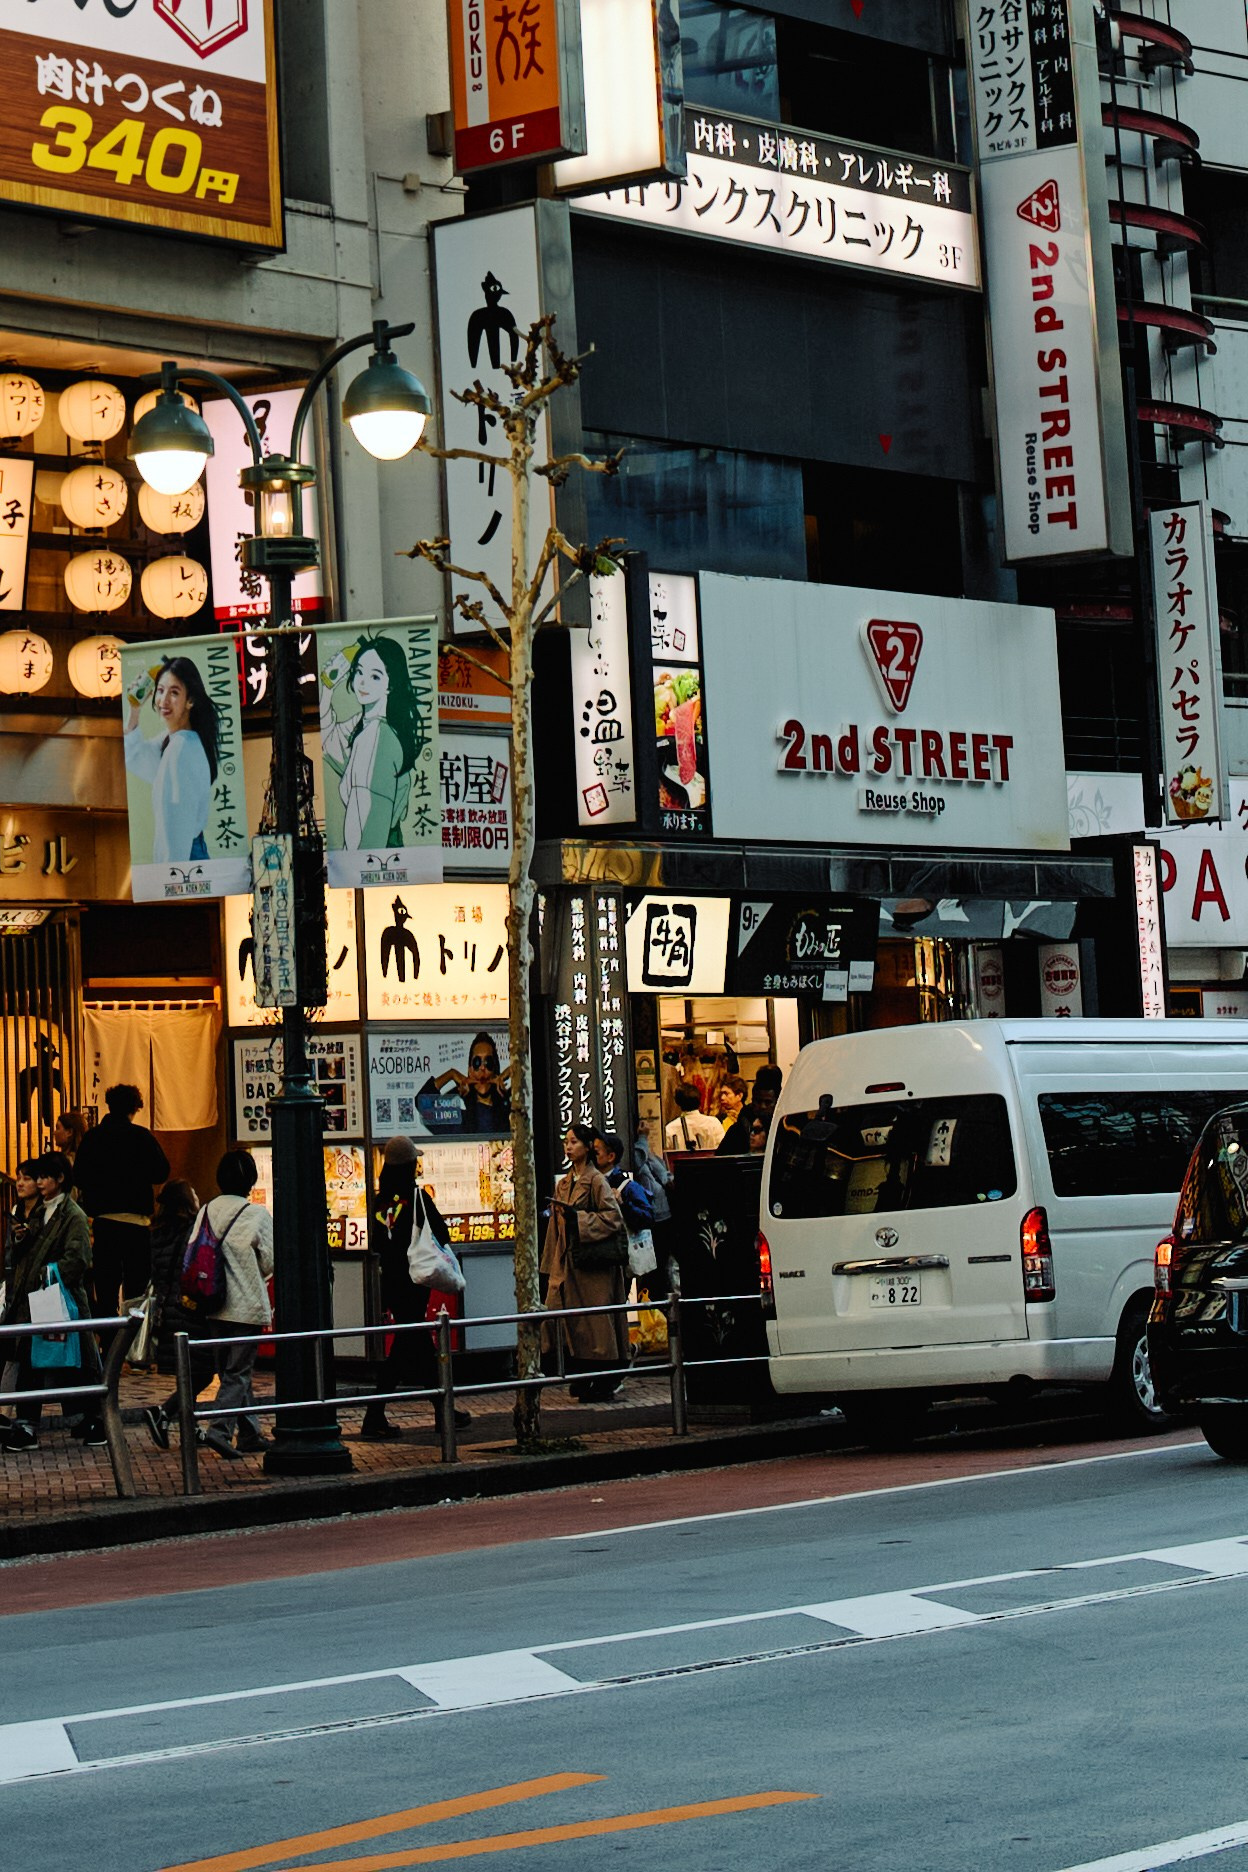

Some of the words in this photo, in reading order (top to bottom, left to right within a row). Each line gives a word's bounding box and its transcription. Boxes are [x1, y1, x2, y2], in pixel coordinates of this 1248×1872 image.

[35, 53, 223, 128] 肉汁つくね
[975, 5, 1005, 138] クリニック
[32, 107, 239, 204] 340円
[489, 122, 526, 155] 6F
[939, 245, 963, 271] 3F
[1028, 241, 1065, 334] 2nd
[7, 380, 26, 422] サワー
[92, 393, 112, 420] ハイ
[1024, 432, 1039, 488] Reuse
[1036, 345, 1079, 532] STREET
[1026, 491, 1040, 536] Shop
[176, 565, 195, 601] レバ
[1163, 512, 1196, 654] カラオケ
[20, 638, 39, 679] たま
[97, 643, 121, 683] 餃子
[207, 646, 236, 763] NAMACHA
[408, 628, 433, 750] NAMACHA
[1169, 659, 1201, 760] パセラ
[776, 718, 859, 774] 2nd
[867, 725, 1014, 784] STREET
[213, 784, 245, 849] 生茶
[412, 770, 439, 836] 生茶
[468, 809, 508, 825] 飲み放題
[864, 788, 907, 811] Reuse
[912, 790, 946, 816] Shop
[454, 905, 483, 924] 酒場
[570, 898, 586, 962] 整形外科
[742, 904, 760, 932] 9F
[438, 934, 504, 976] トリノ
[572, 972, 588, 1005] 内科
[763, 974, 823, 990] 全身もみほぐし
[575, 1013, 590, 1063] 皮膚科
[370, 1056, 431, 1075] ASOBIBAR
[246, 1082, 275, 1099] BAR
